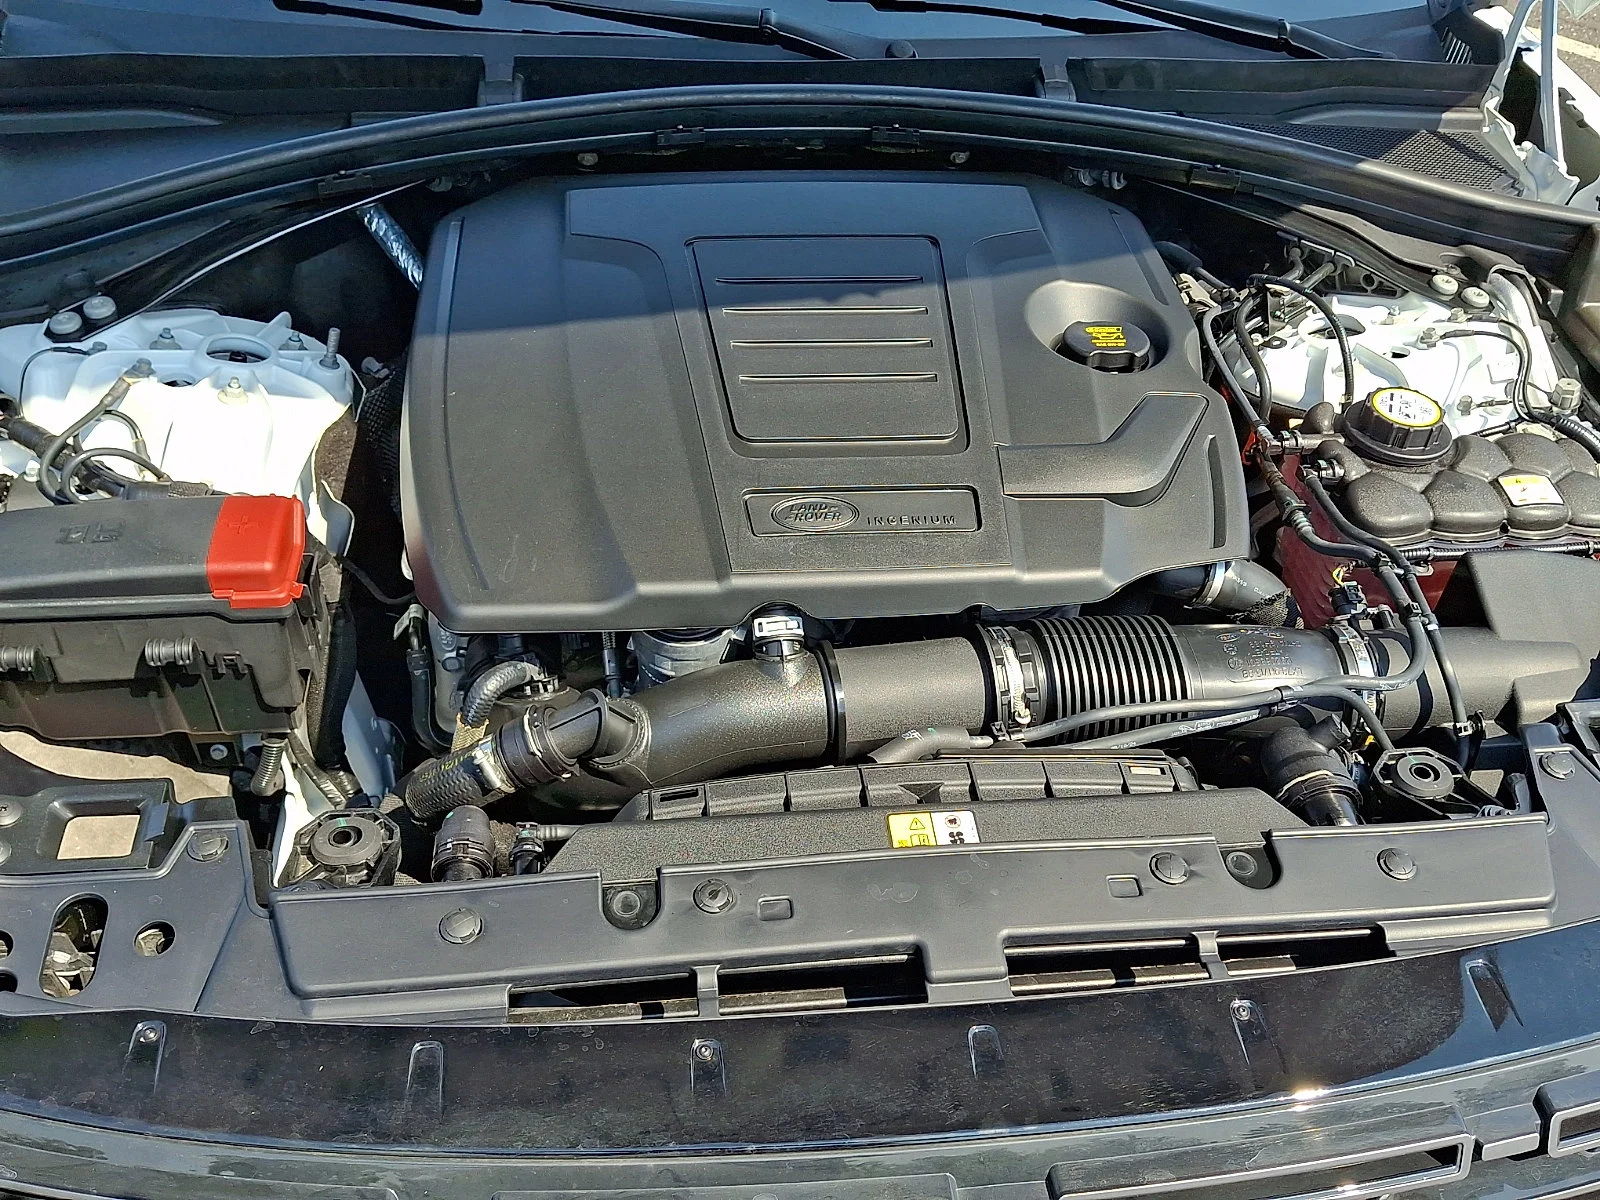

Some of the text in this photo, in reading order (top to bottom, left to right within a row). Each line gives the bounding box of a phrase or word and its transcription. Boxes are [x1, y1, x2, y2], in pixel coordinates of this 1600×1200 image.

[789, 503, 828, 513] LAND
[793, 511, 842, 523] ROVER
[867, 515, 956, 527] INGENIUM
